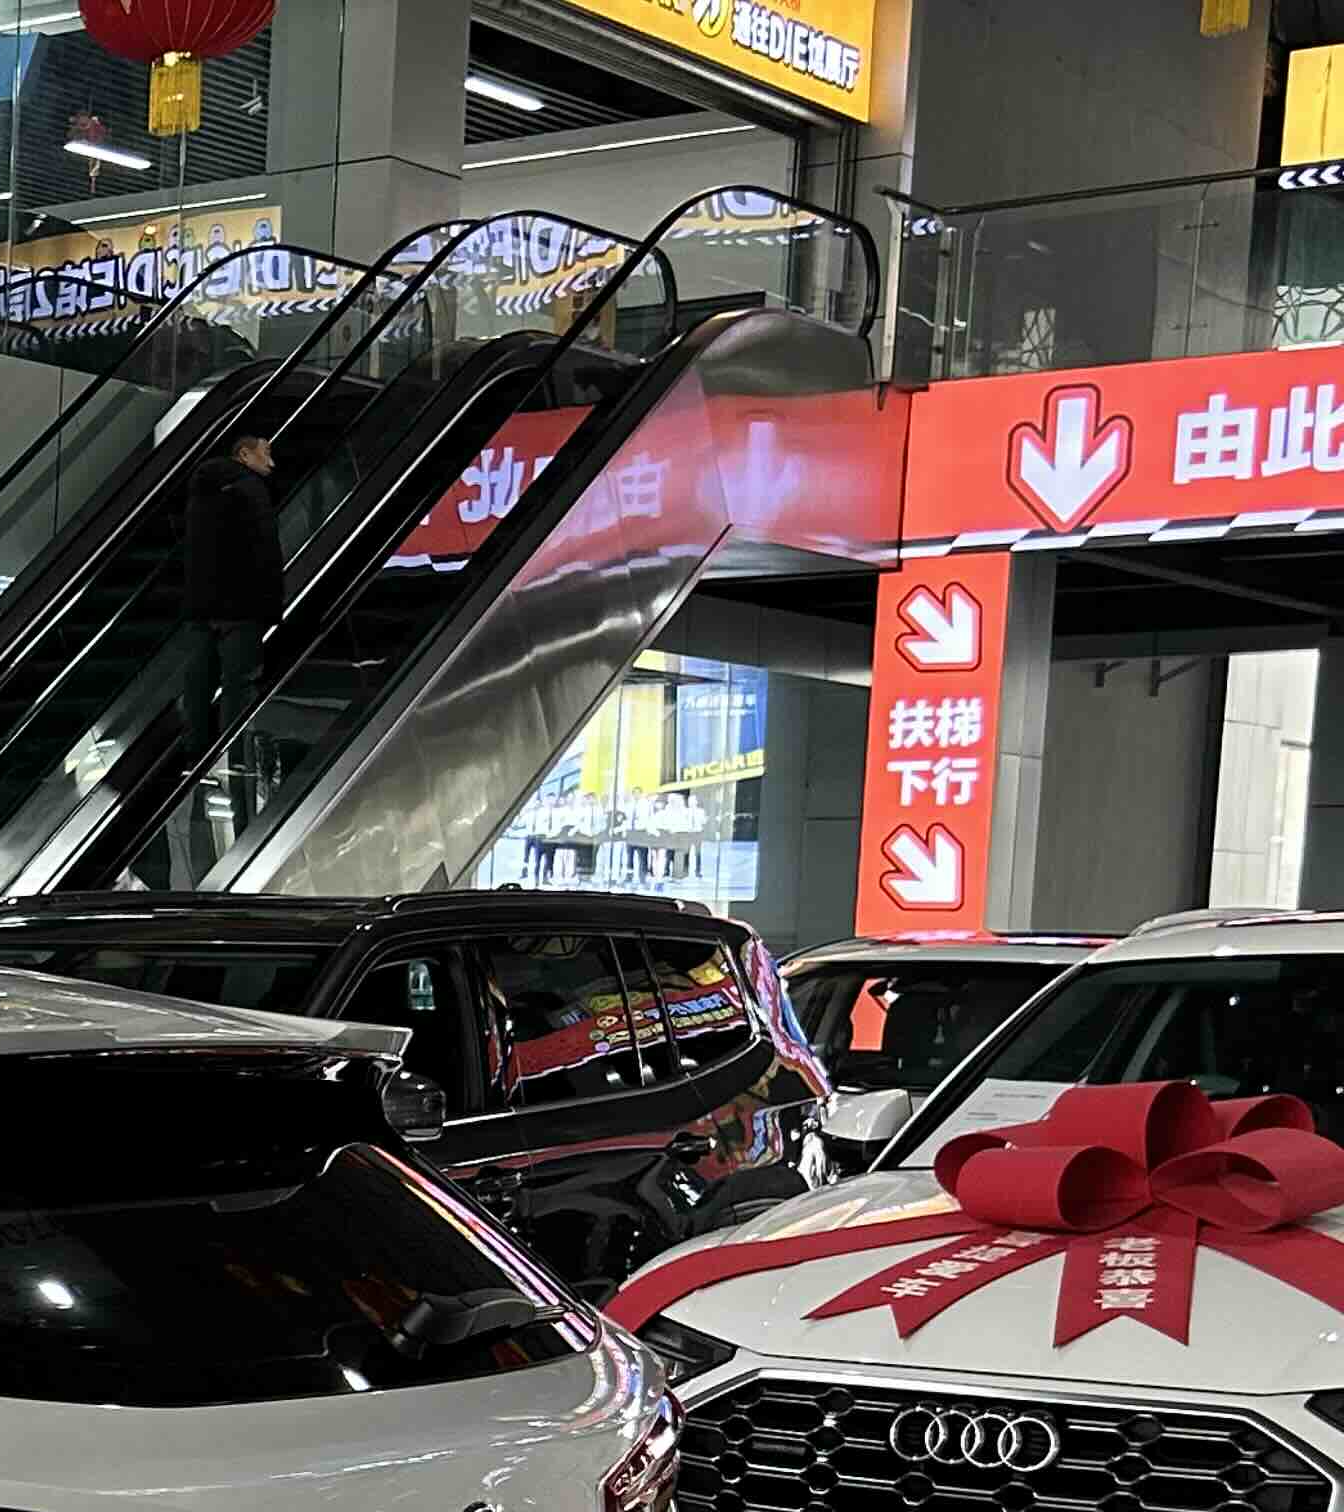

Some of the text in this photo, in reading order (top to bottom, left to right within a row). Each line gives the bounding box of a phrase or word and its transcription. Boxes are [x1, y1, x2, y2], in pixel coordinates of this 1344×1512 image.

[1173, 384, 1344, 485] 由此
[887, 697, 984, 750] 扶梯
[886, 756, 979, 808] 下行
